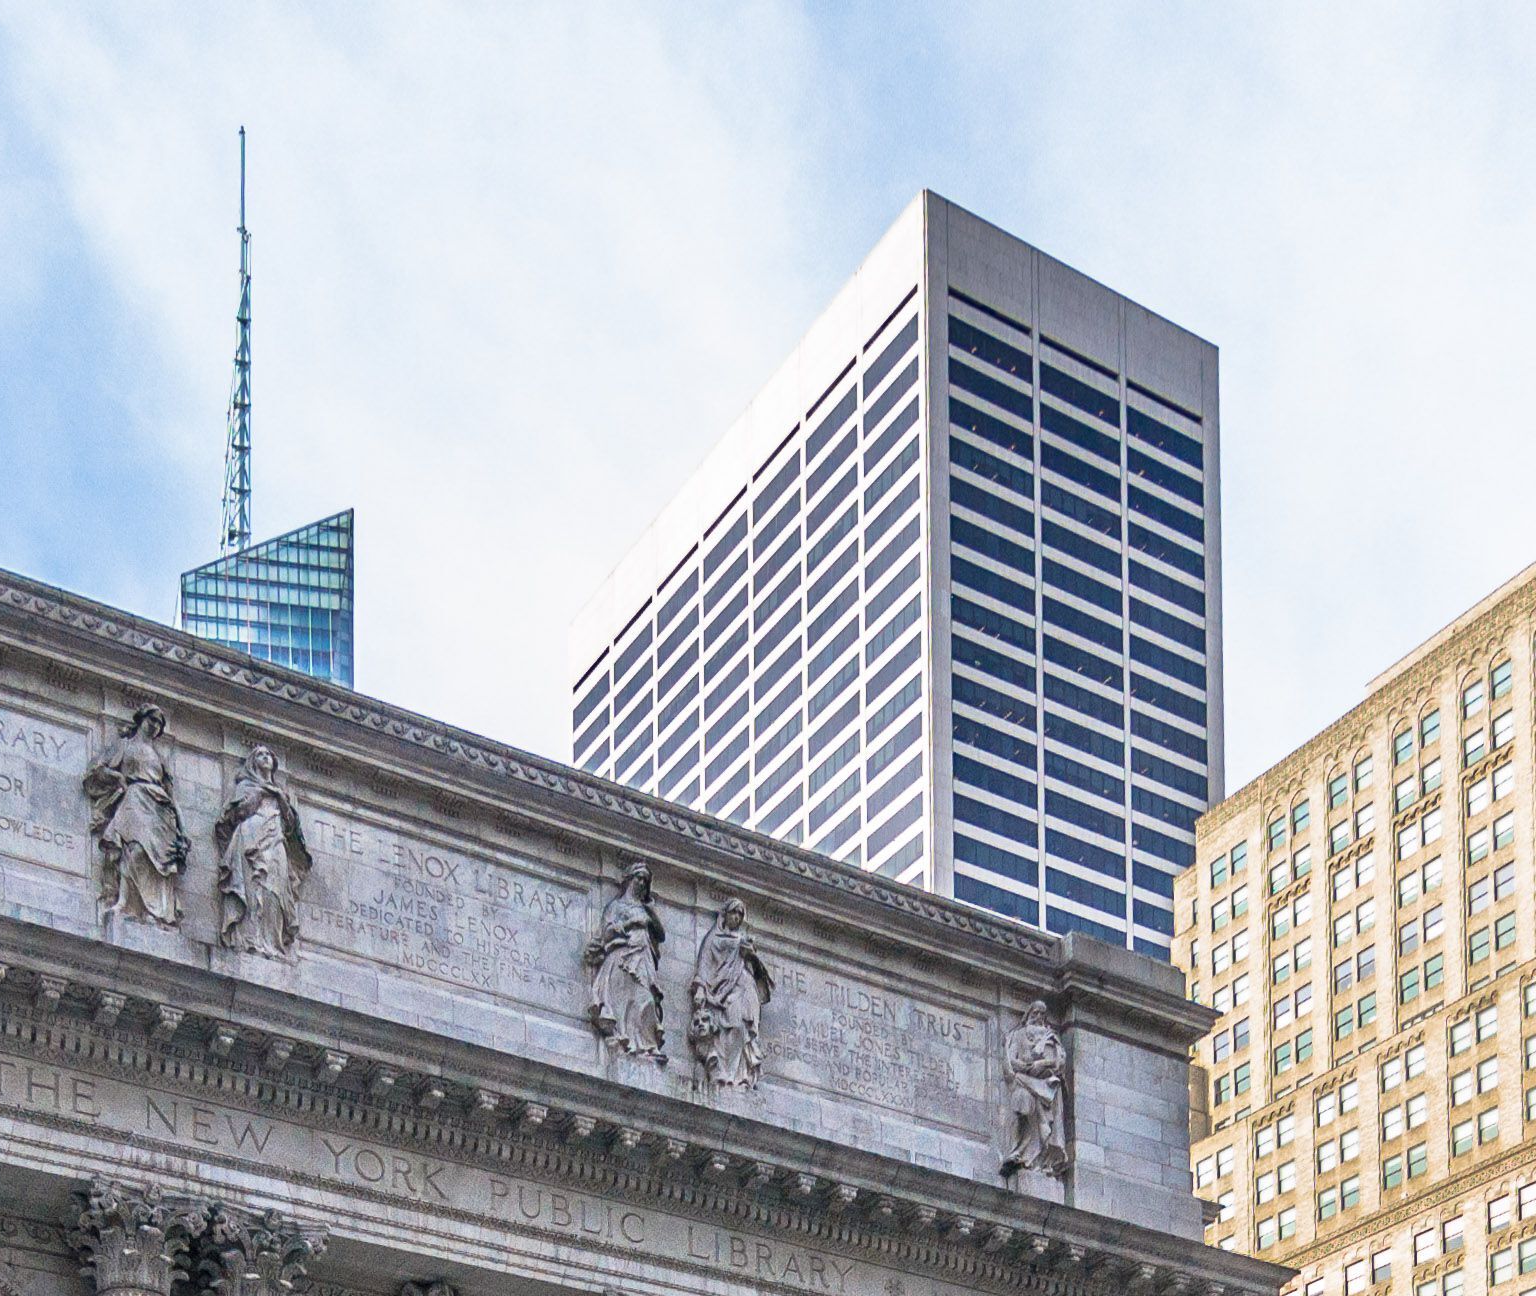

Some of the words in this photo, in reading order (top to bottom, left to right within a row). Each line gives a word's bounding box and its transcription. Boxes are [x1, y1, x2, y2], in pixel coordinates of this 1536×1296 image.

[314, 820, 363, 854] THE
[377, 839, 460, 884] LENOX
[474, 868, 572, 917] LIBRARY
[394, 877, 464, 909] FOUNDED
[481, 906, 497, 918] BY
[349, 901, 434, 935] DEDICATED
[477, 939, 540, 964] HISTORY
[374, 889, 439, 921] JAMES
[456, 911, 518, 945] LENOX
[310, 910, 408, 946] LITERATURE
[422, 940, 451, 958] AND
[464, 952, 489, 971] THE
[499, 962, 532, 983] FINE
[538, 975, 575, 995] ARTS
[767, 963, 807, 993] THE
[825, 981, 898, 1021] TILDEN
[914, 1008, 974, 1041] TRUST
[831, 1011, 888, 1039] FOUNDED
[791, 1016, 847, 1045] SAMUEL
[855, 1036, 901, 1060] JONES
[145, 1100, 272, 1155] NEW
[322, 1138, 449, 1202] YORK
[488, 1178, 646, 1245] PUBLIC
[688, 1225, 855, 1294] LIBRARY
